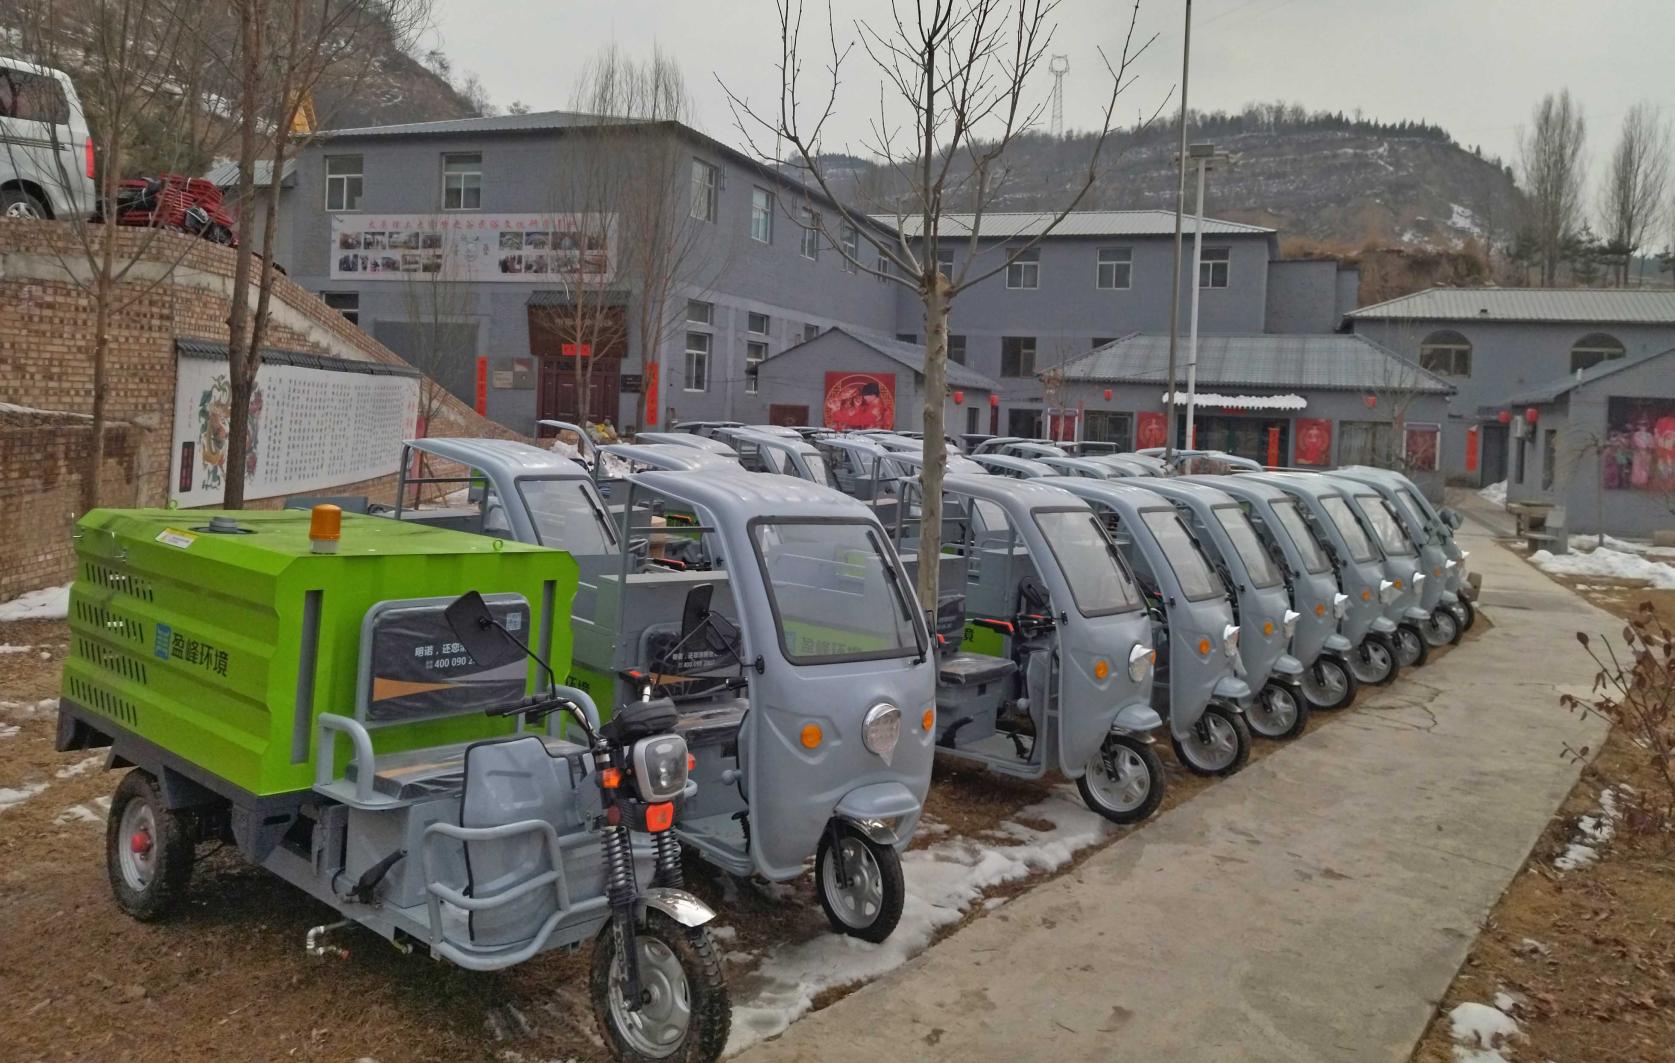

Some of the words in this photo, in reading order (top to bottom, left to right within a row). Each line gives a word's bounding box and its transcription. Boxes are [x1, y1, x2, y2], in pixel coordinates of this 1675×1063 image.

[171, 632, 229, 678] 盈峰环境
[434, 659, 450, 669] 400
[451, 656, 467, 667] 090
